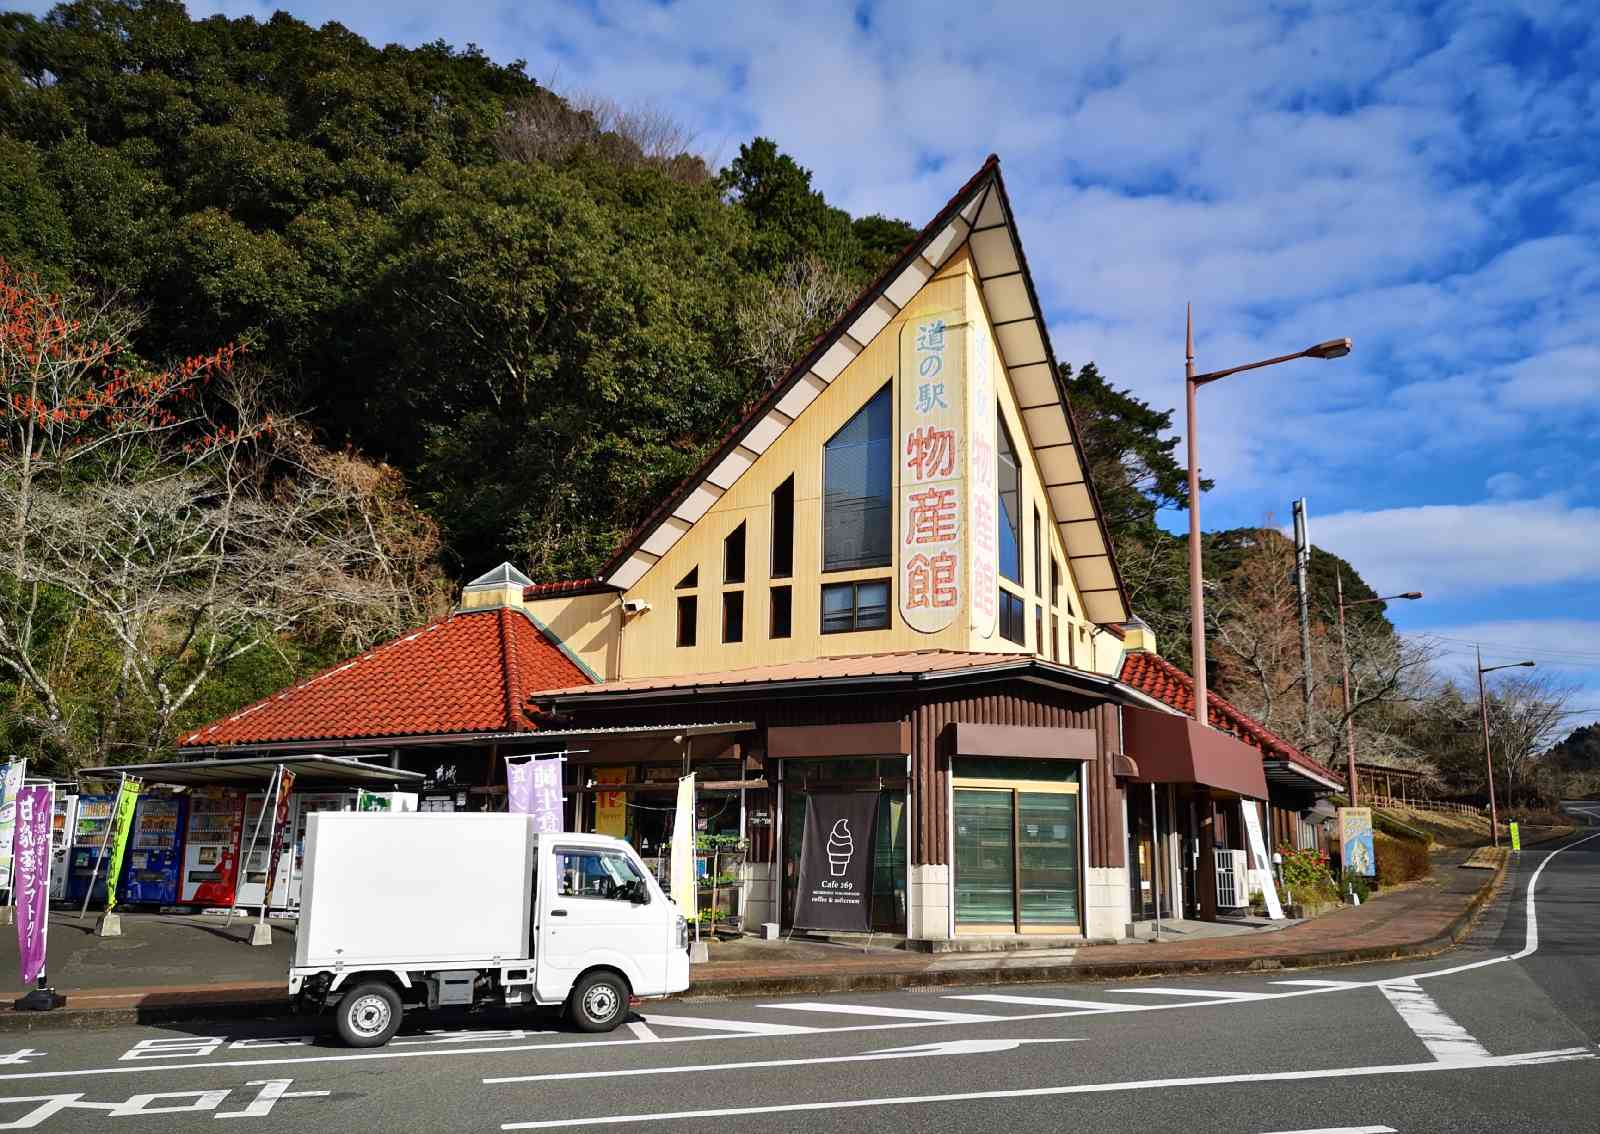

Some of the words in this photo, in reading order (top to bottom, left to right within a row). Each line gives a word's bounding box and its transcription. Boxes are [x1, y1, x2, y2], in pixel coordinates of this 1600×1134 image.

[916, 320, 948, 413] 道の駅
[905, 426, 958, 610] 物産館
[972, 433, 994, 617] 物産館
[821, 880, 839, 889] Cafe
